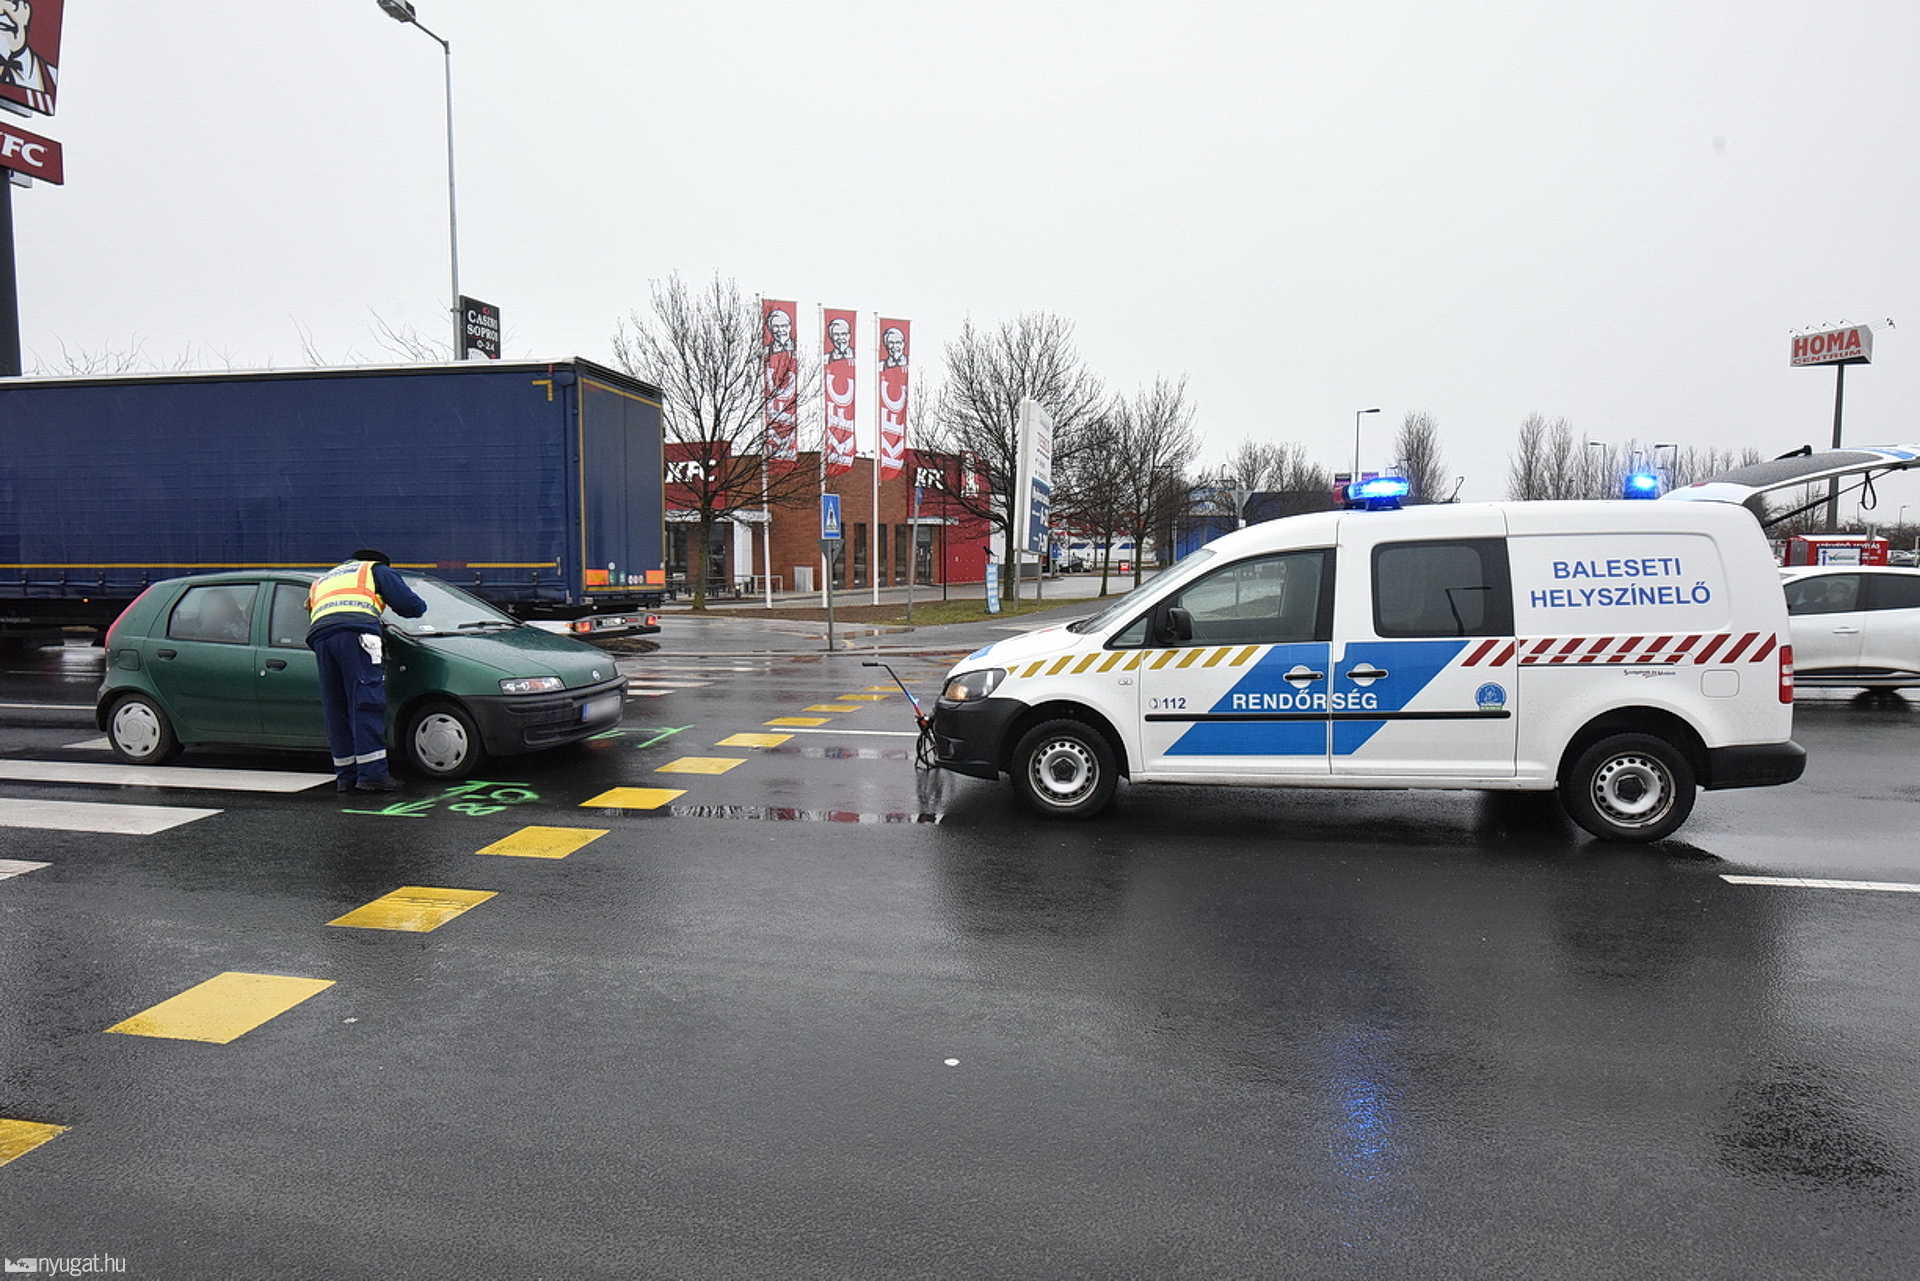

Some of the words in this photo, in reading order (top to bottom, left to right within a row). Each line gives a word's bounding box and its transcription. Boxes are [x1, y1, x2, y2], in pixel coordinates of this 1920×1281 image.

[0, 131, 46, 167] FC
[1793, 329, 1861, 357] HOMA
[1793, 350, 1863, 364] CENTRUM
[826, 373, 854, 466] KFC
[880, 380, 906, 468] KFC
[1552, 558, 1681, 579] BALESETI
[1530, 581, 1711, 608] HELYSZÍNELŐ
[1162, 697, 1186, 709] 112
[1232, 688, 1378, 710] RENDŐRSÉG
